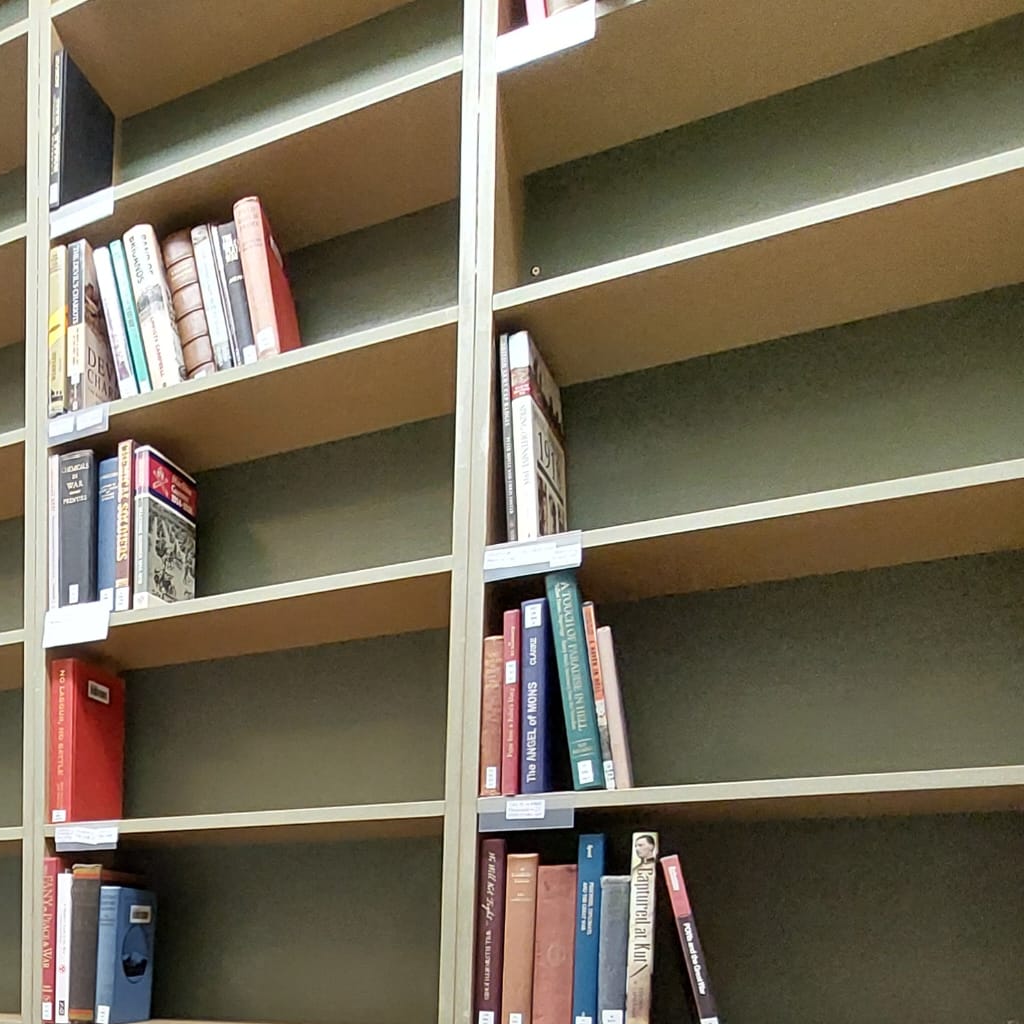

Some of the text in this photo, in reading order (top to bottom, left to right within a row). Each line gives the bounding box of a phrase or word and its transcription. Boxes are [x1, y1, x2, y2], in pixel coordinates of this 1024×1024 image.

[66, 480, 84, 490] WAR
[559, 581, 570, 590] A
[560, 591, 575, 627] TOUCH
[58, 669, 66, 683] NO
[525, 636, 538, 783] The ANGEL of MONS CLARKE
[56, 742, 65, 776] BATTLE
[487, 863, 496, 881] Will
[43, 874, 54, 906] FANY
[633, 867, 652, 963] Captured at Kut
[42, 913, 53, 940] PEACE
[687, 941, 698, 955] and
[42, 948, 53, 969] WAR
[691, 953, 701, 965] the
[693, 963, 706, 981] Great
[696, 980, 709, 997] War
